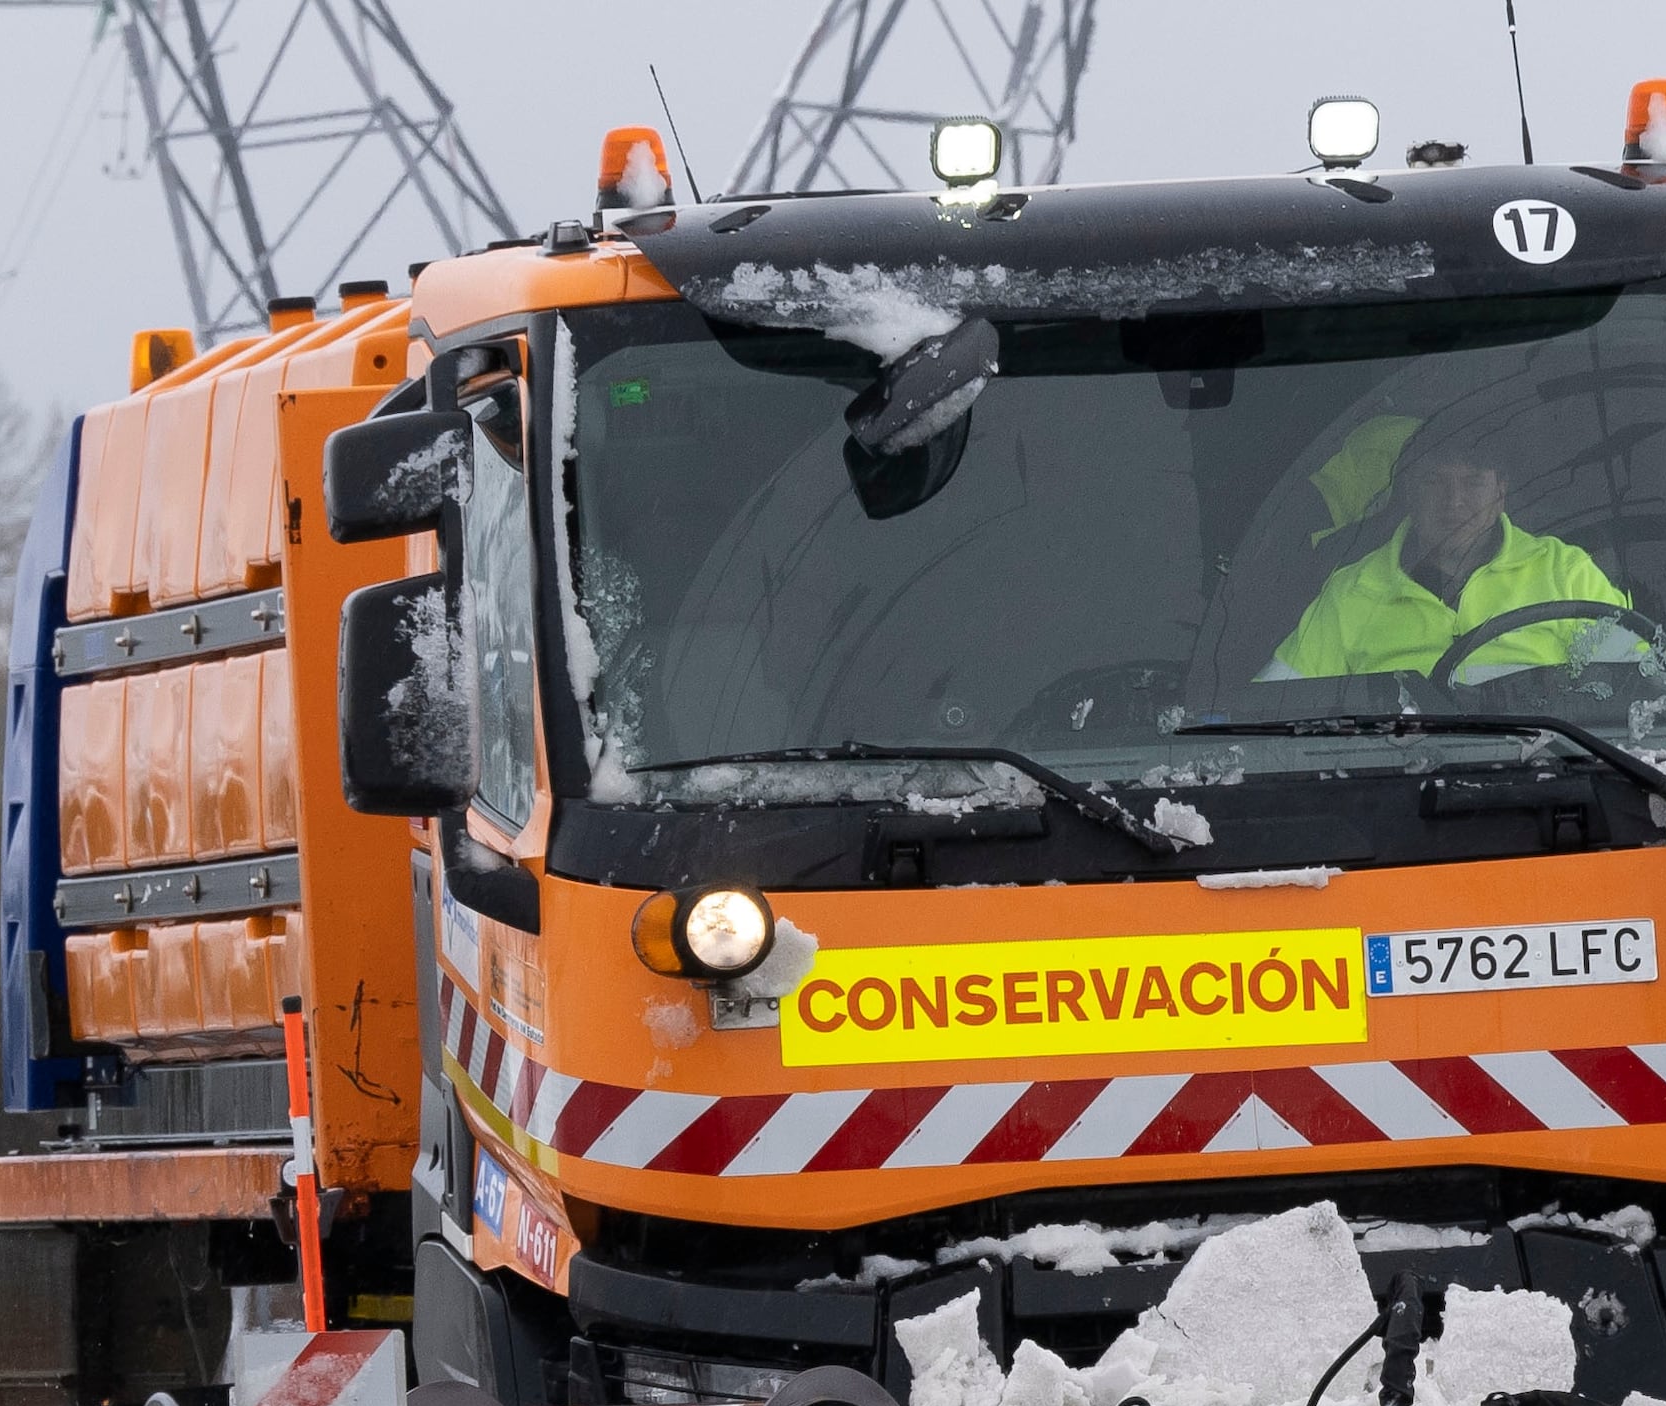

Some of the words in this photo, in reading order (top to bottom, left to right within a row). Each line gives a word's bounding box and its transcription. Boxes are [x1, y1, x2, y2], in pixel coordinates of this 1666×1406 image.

[1503, 207, 1559, 252] 17
[1375, 970, 1387, 984] E
[1404, 934, 1530, 985] 5762
[1549, 927, 1641, 976] LFC
[797, 948, 1351, 1033] CONSERVACIÓN
[475, 1160, 505, 1225] A-67
[517, 1204, 557, 1278] N-611
